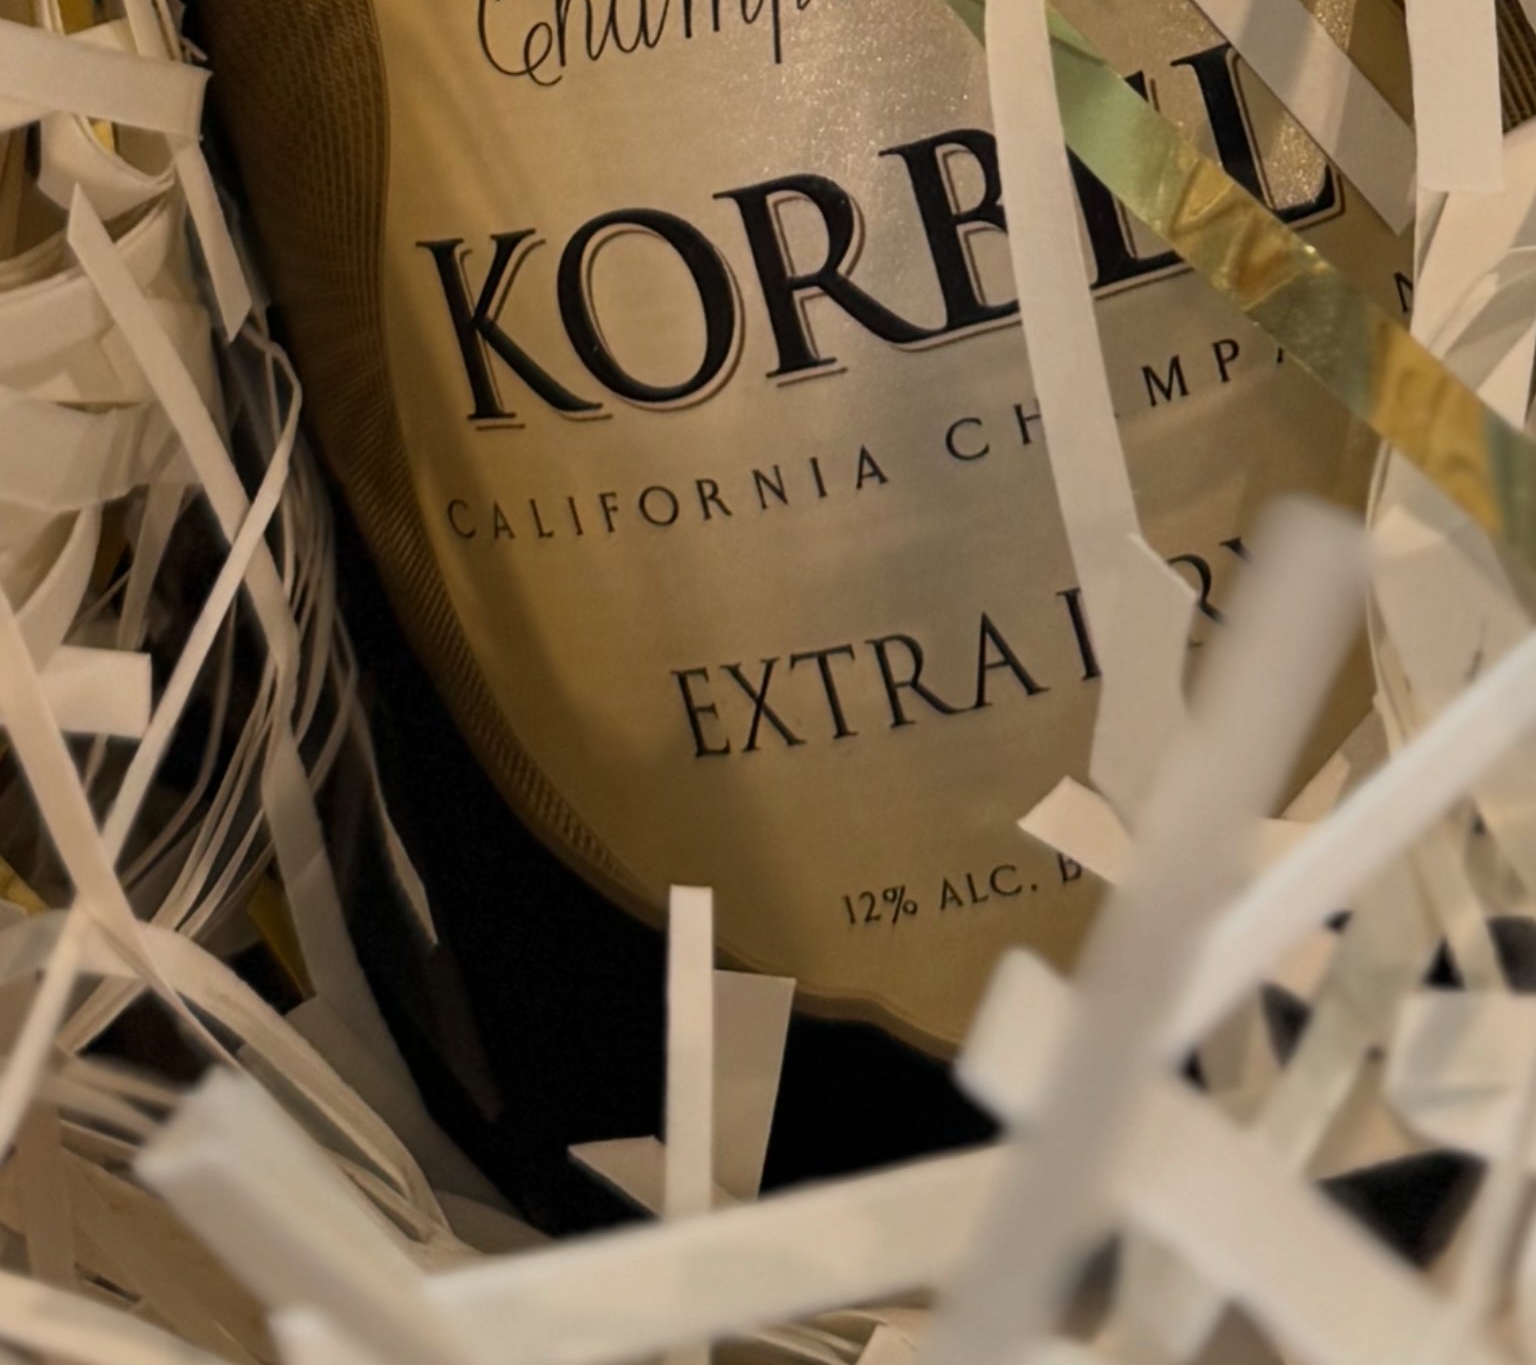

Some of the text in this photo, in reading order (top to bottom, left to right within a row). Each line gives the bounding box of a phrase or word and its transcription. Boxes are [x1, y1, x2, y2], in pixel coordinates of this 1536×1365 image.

[446, 443, 889, 541] CALIFORNIA
[671, 610, 1051, 759] EXTRA
[842, 884, 919, 926] 12%
[940, 863, 1039, 911] ALC.
